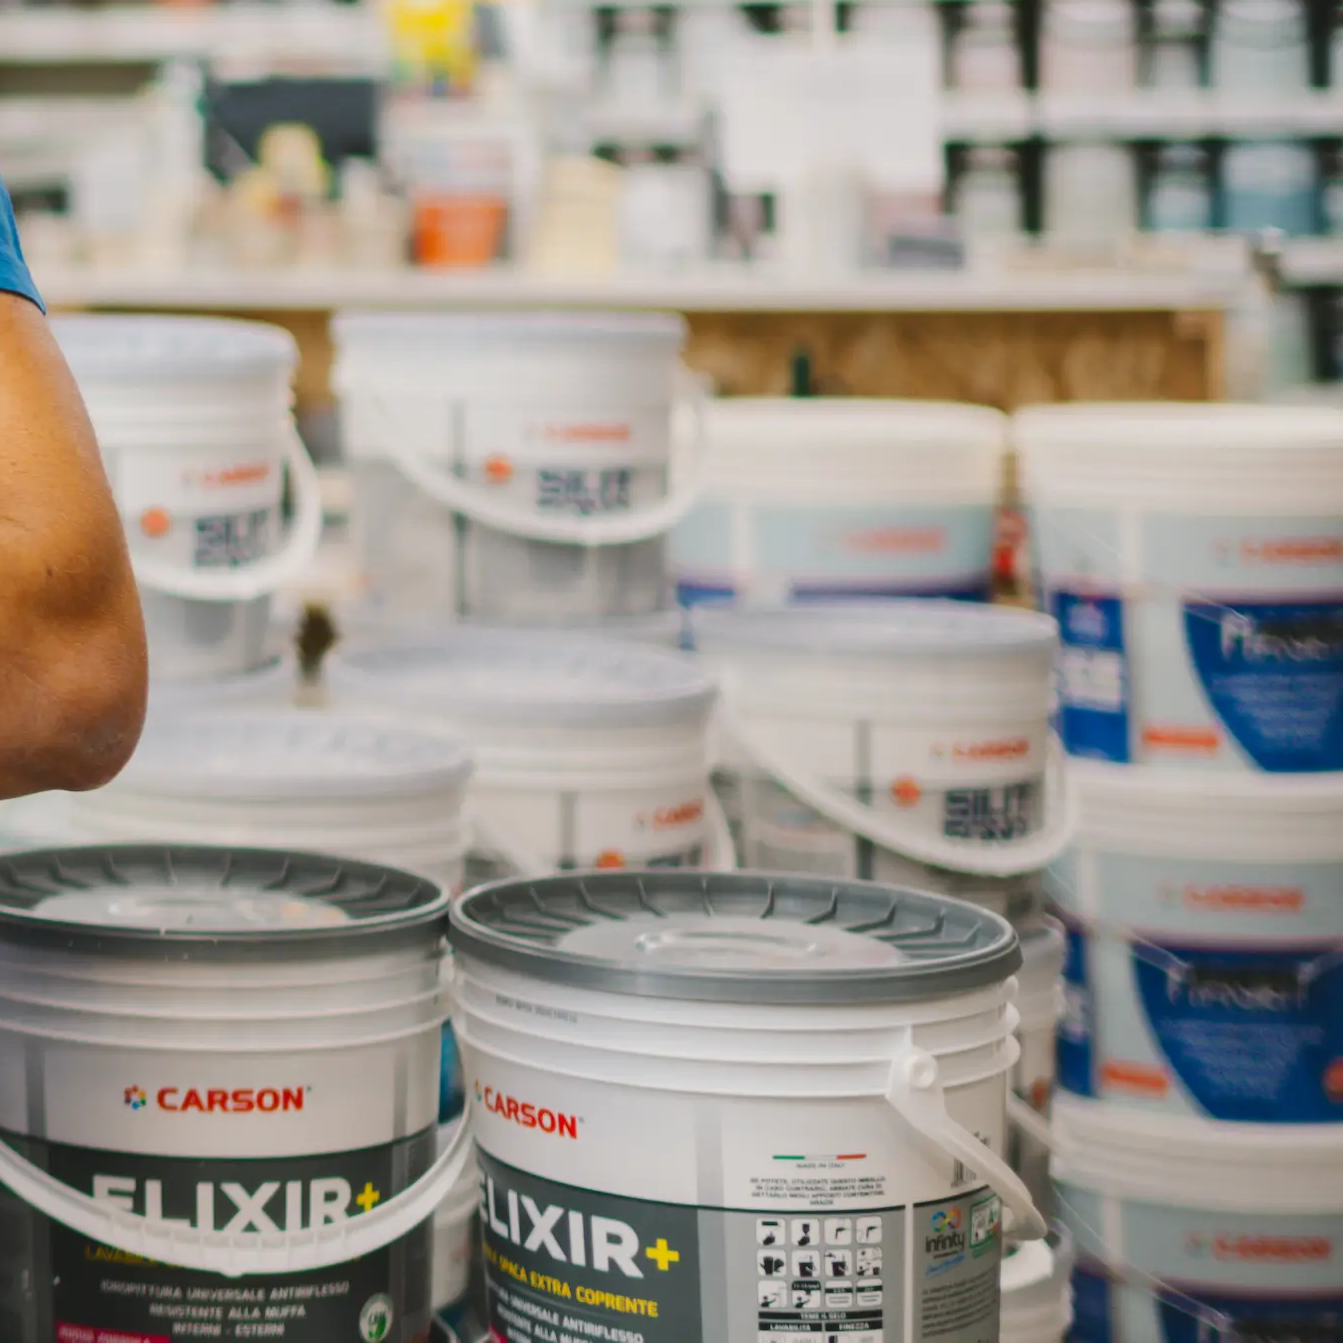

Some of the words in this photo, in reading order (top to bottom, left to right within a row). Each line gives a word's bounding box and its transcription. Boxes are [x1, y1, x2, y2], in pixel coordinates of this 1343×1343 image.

[156, 1085, 304, 1113] CARSON
[484, 1085, 578, 1140] CARSON
[529, 1270, 572, 1300] EXTRA
[576, 1285, 660, 1319] COPRENTE
[228, 1304, 262, 1320] ALLA
[562, 1314, 645, 1343] ANTIRIFLESSO
